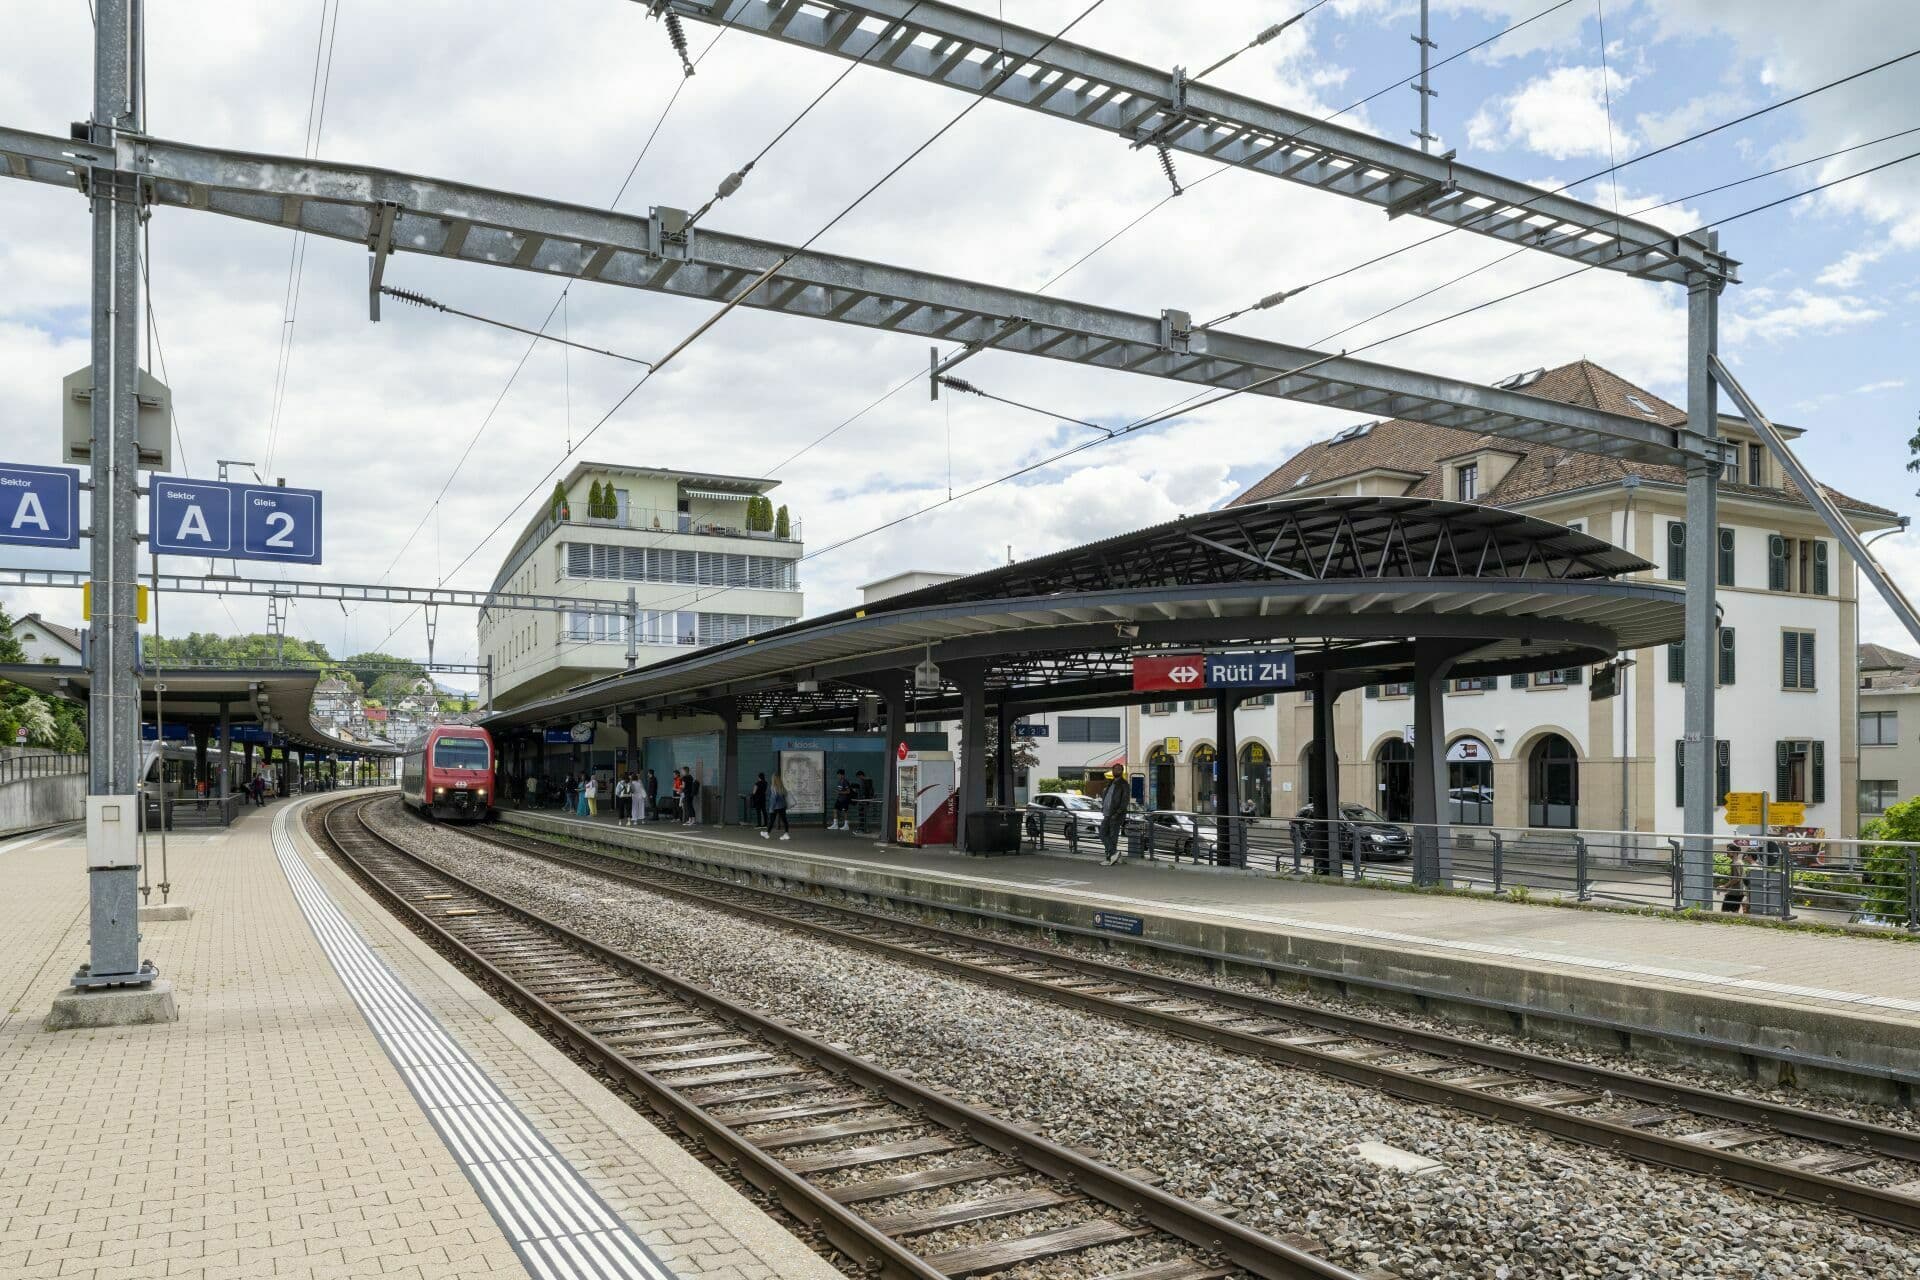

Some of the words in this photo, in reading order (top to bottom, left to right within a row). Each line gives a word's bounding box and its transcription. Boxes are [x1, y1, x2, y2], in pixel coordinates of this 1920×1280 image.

[0, 477, 32, 488] Sektor
[167, 491, 196, 501] Sektor
[253, 498, 277, 508] Gleis
[10, 492, 50, 531] A
[176, 505, 212, 542] A
[265, 511, 295, 548] 2
[1212, 664, 1253, 682] Rüti
[1259, 663, 1287, 681] ZH
